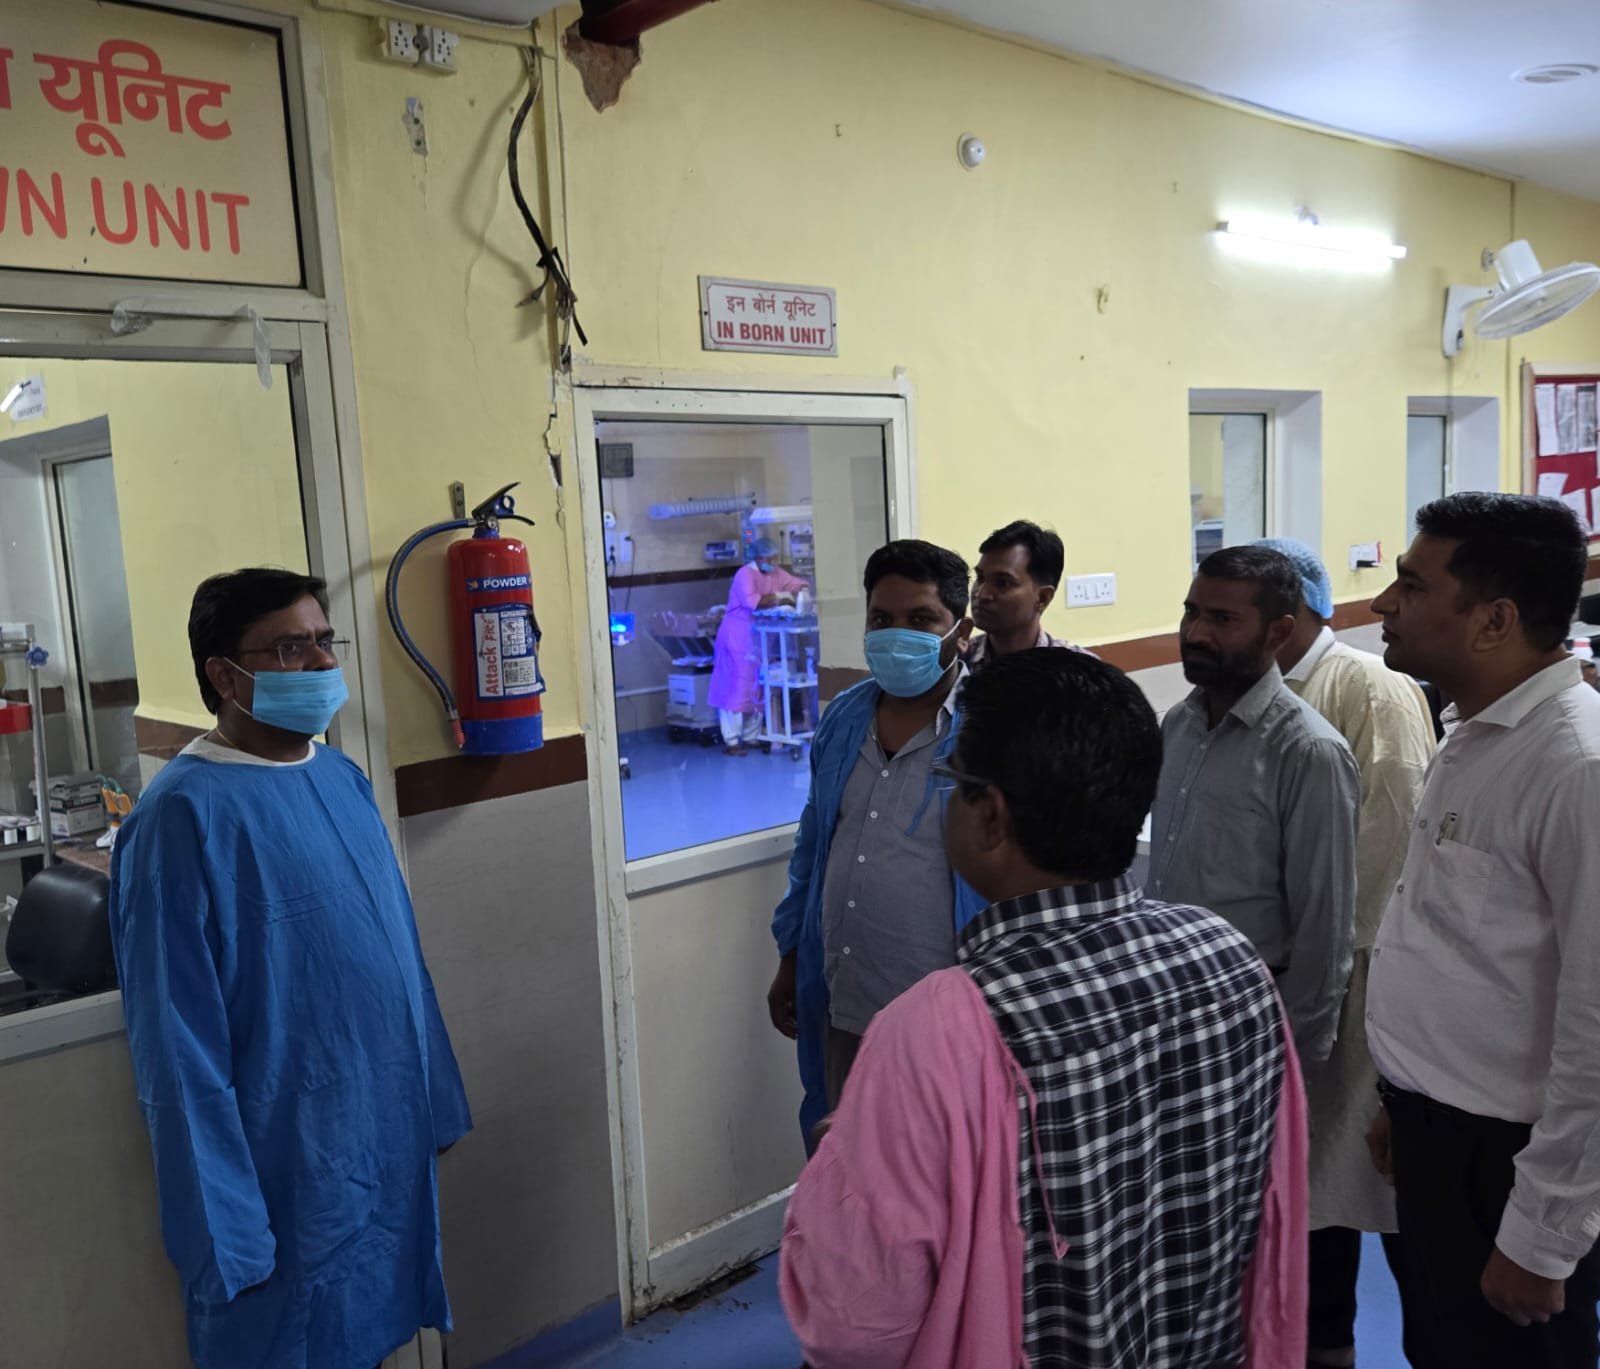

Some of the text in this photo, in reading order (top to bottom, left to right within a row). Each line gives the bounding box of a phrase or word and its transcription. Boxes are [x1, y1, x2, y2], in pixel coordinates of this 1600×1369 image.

[33, 38, 232, 158] यूनिट
[91, 177, 249, 255] UNIT
[725, 293, 816, 321] इन बोर्न यूनिट
[716, 321, 826, 345] IN BORN UNIT
[483, 576, 528, 589] POWDER
[484, 646, 500, 695] Attack
